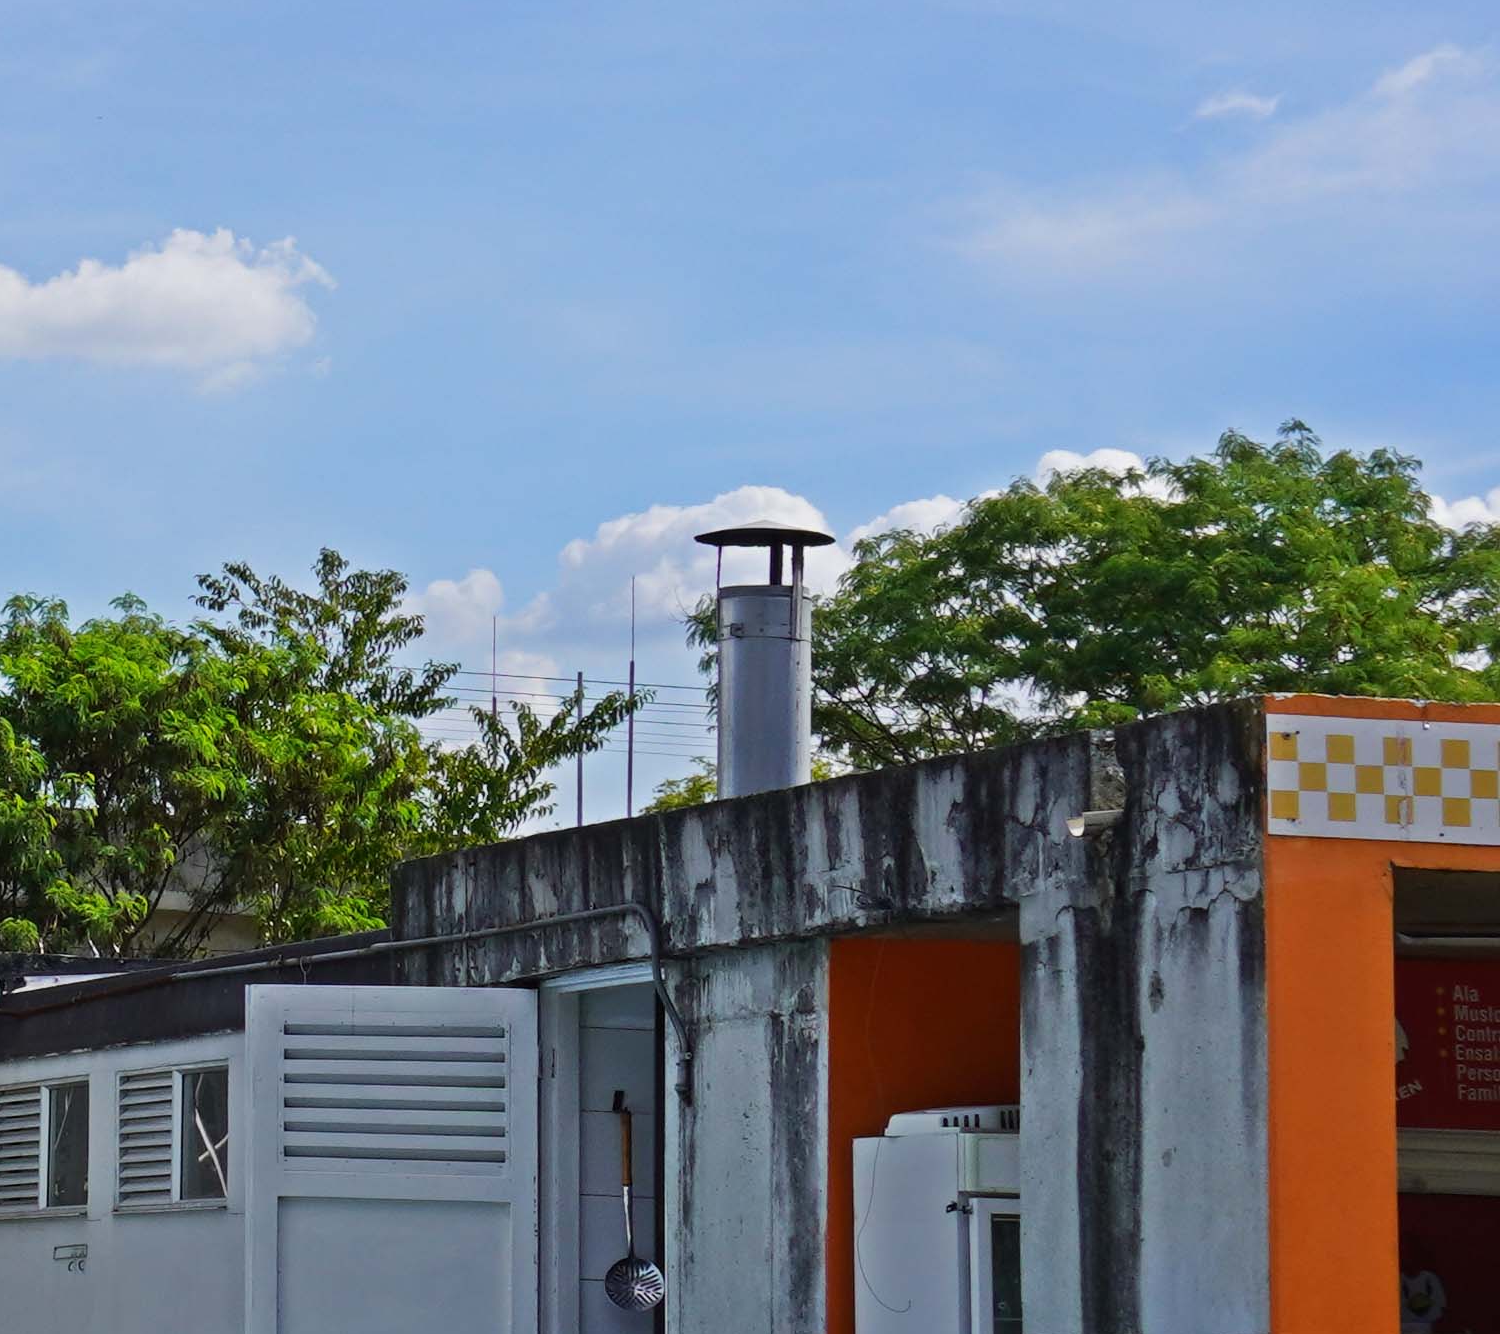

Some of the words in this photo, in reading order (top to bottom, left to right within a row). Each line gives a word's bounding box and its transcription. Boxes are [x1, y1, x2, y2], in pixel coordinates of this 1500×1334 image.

[1453, 985, 1480, 1002] Ala
[1455, 1025, 1500, 1042] Contr
[1455, 1044, 1500, 1061] Ensal
[1396, 1079, 1422, 1101] EN
